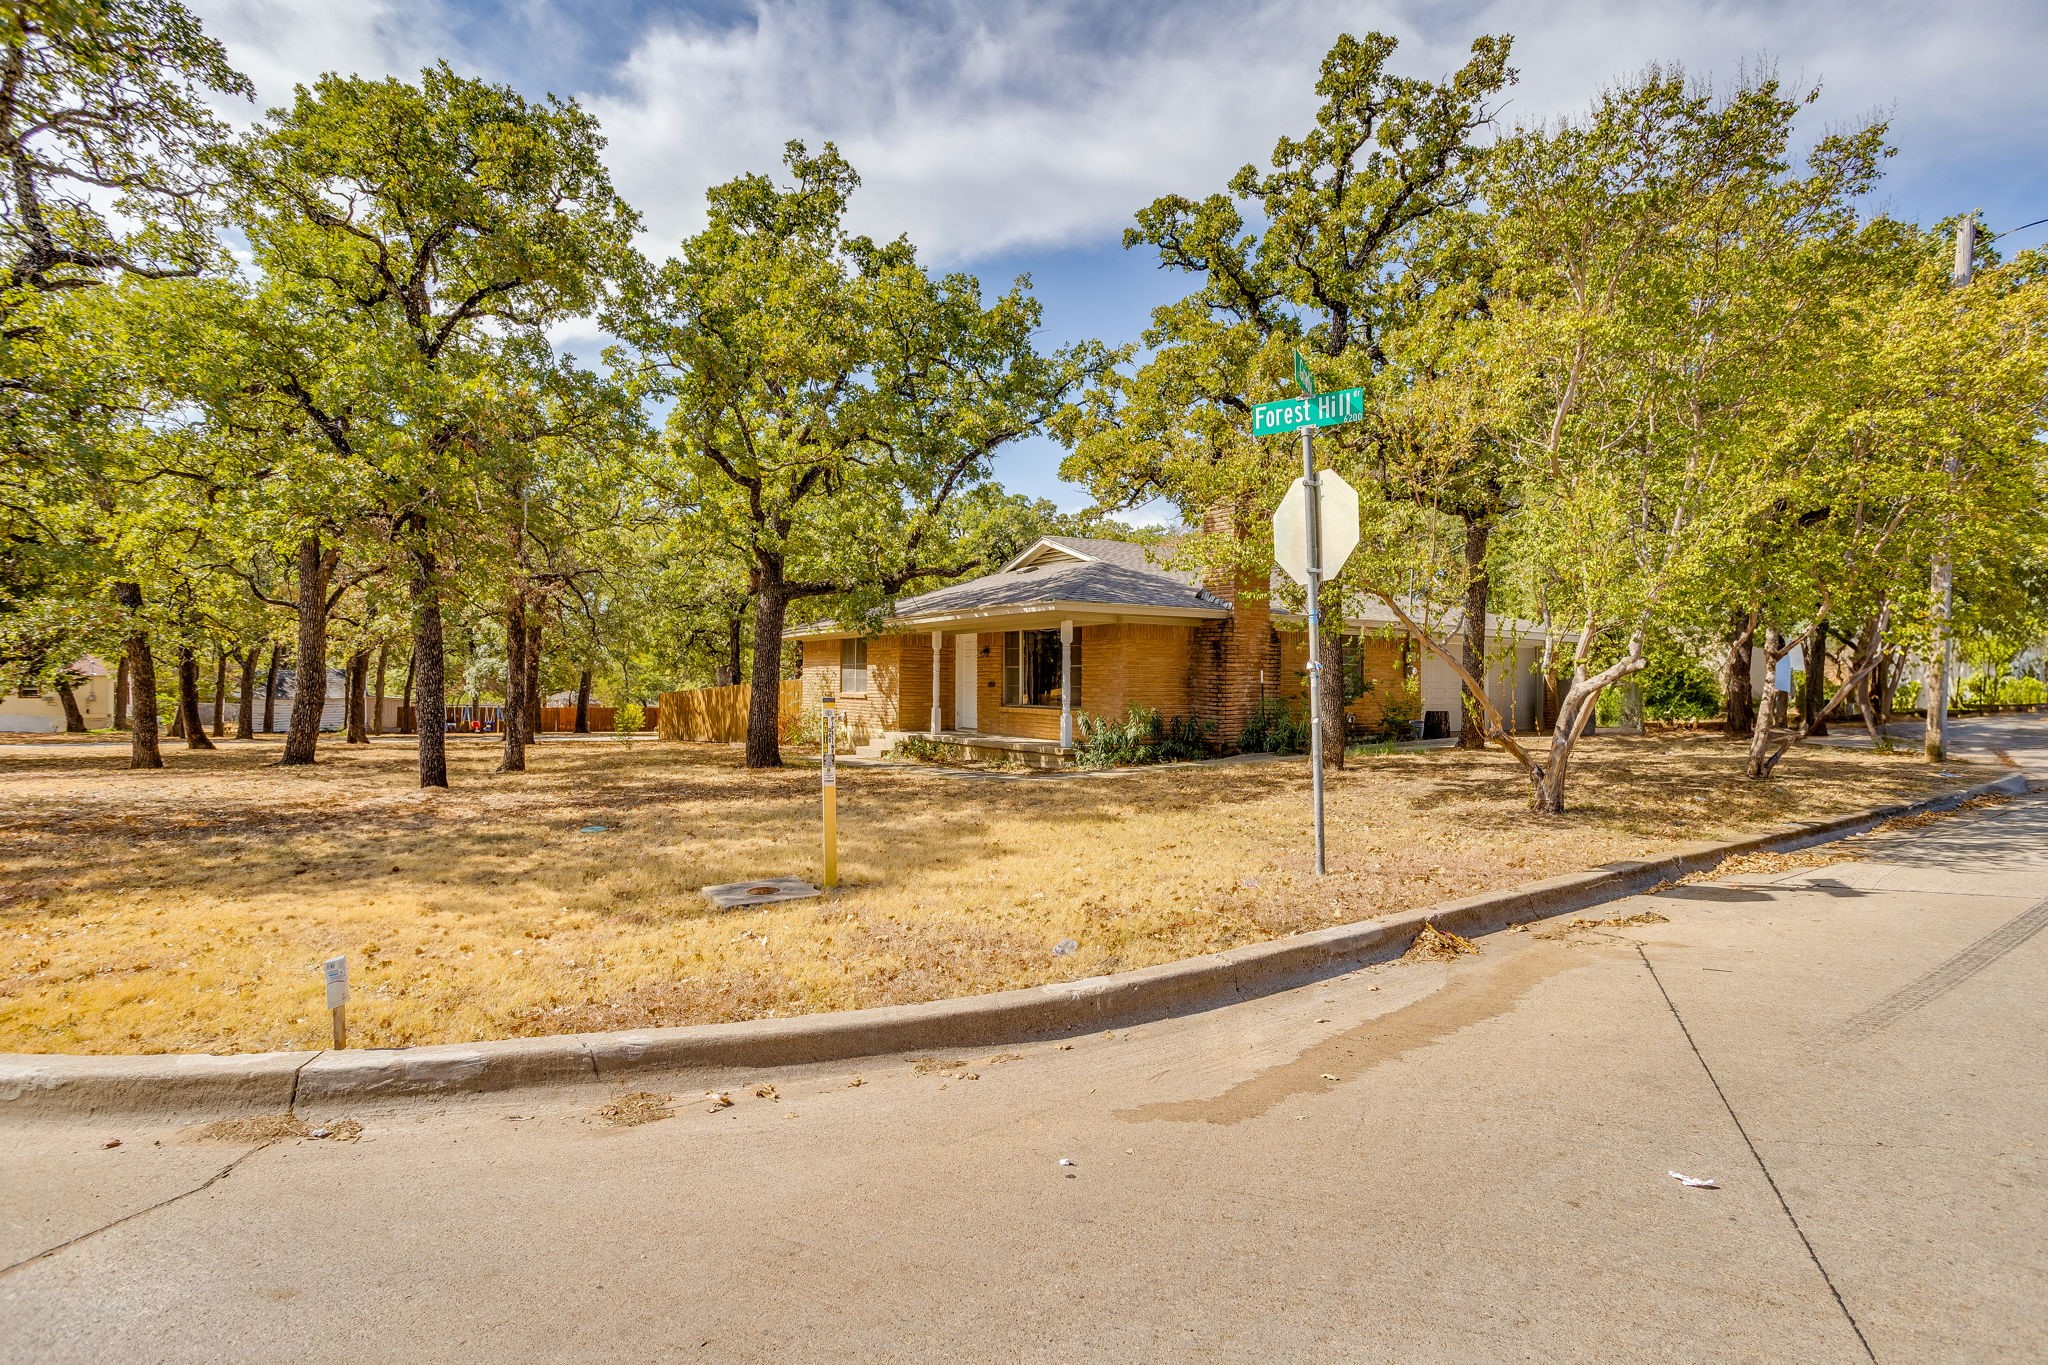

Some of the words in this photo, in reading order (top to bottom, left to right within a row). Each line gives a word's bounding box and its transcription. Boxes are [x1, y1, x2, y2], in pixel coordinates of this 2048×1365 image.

[1255, 400, 1310, 429] Forest
[1318, 393, 1351, 419] Hill
[1343, 412, 1363, 423] 6200
